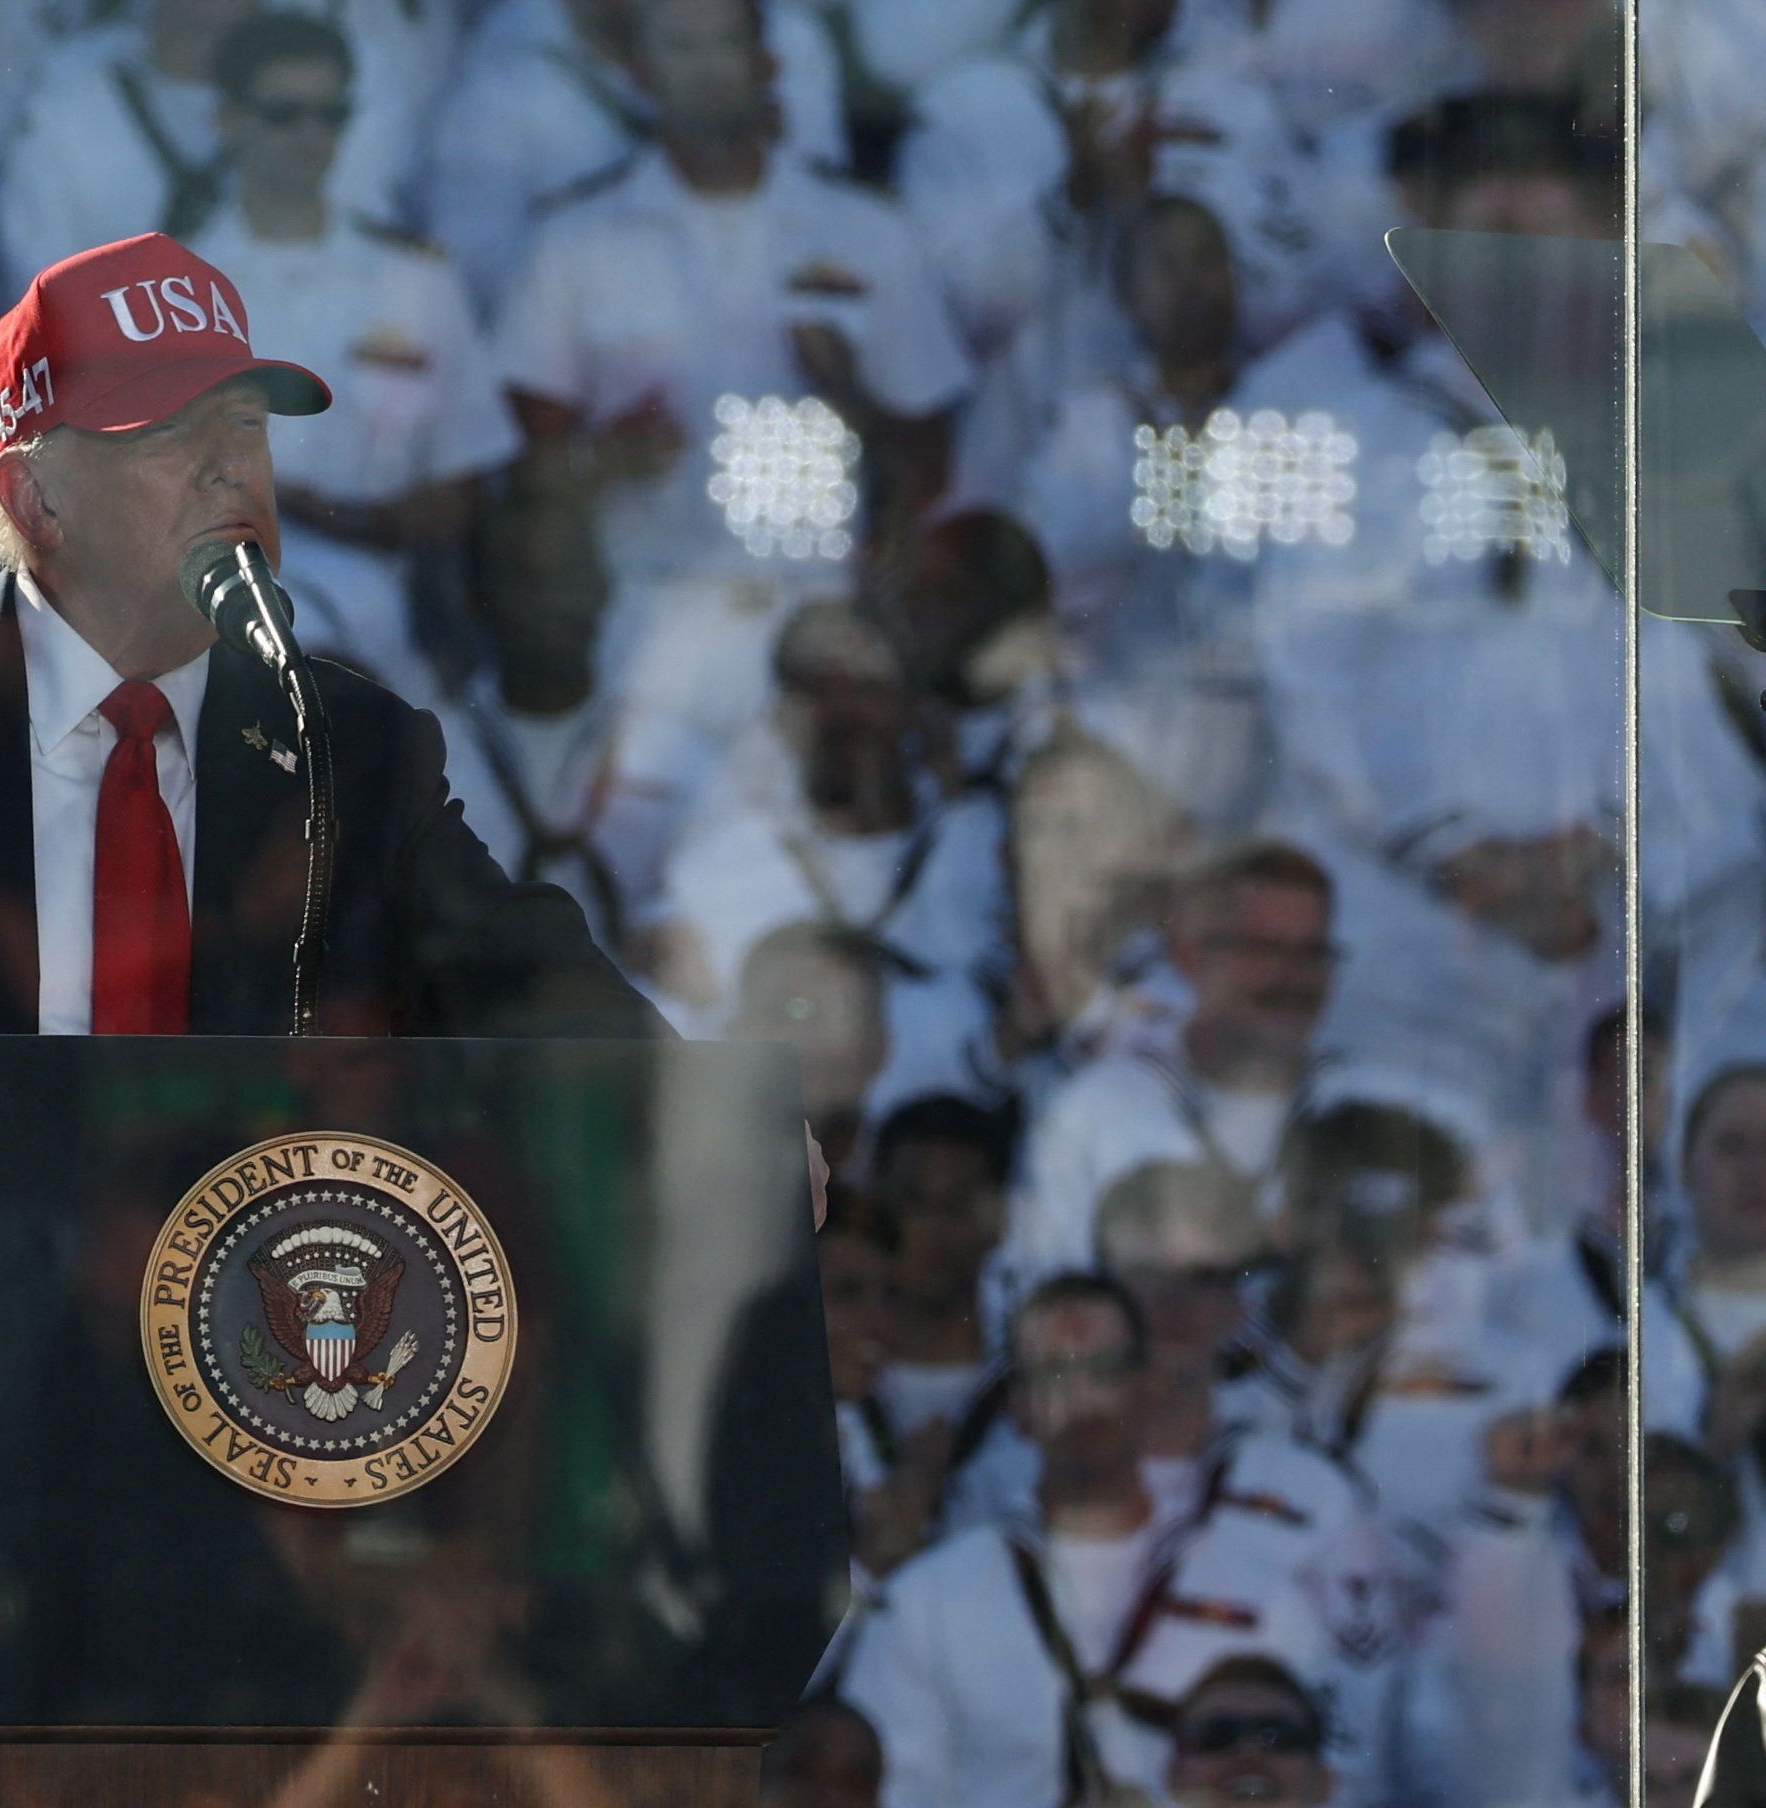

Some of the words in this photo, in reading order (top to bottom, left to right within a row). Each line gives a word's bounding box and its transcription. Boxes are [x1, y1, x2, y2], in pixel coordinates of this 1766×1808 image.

[100, 275, 248, 345] USA
[331, 1148, 366, 1173] OF
[373, 1156, 419, 1194] THE
[154, 1145, 319, 1310] PRESIDENT
[298, 1271, 338, 1283] PLURIBUS
[339, 1276, 364, 1285] UNUM
[426, 1189, 505, 1343] UNITED
[158, 1324, 186, 1376] THE
[174, 1382, 202, 1412] OF
[202, 1411, 297, 1489] SEAL
[365, 1377, 490, 1490] STATES
